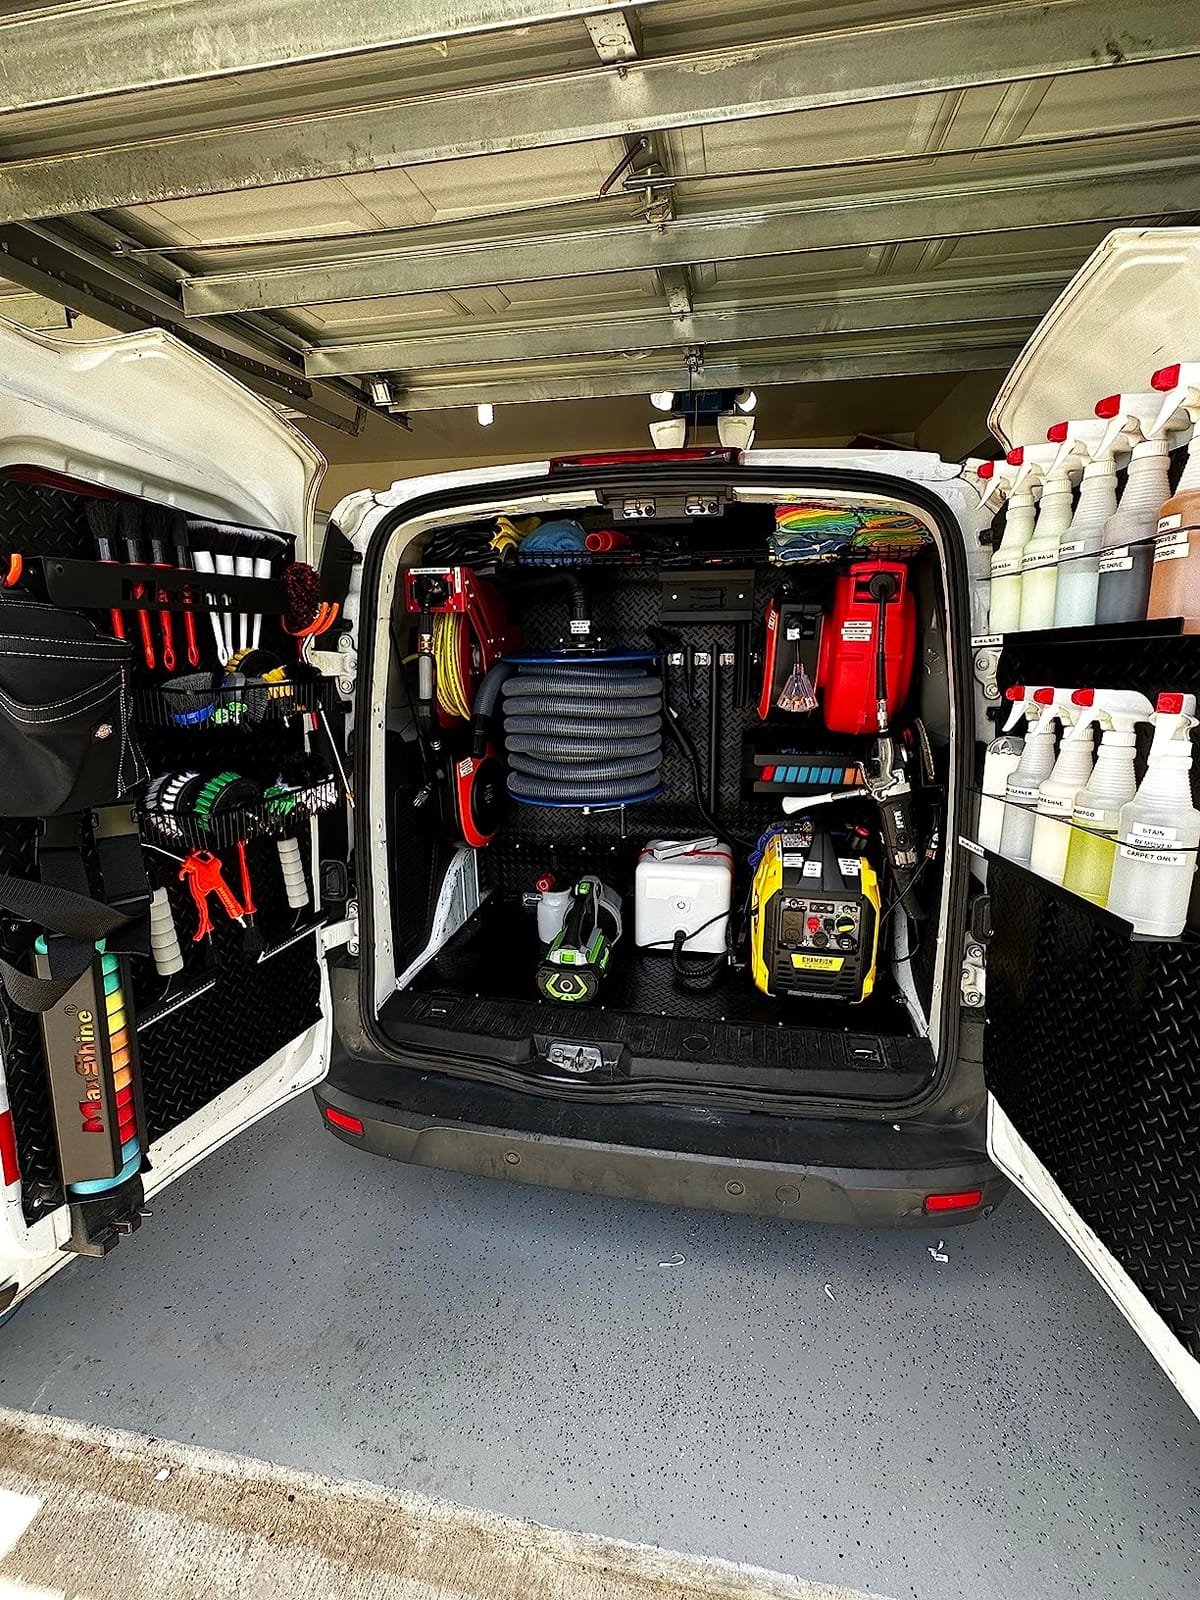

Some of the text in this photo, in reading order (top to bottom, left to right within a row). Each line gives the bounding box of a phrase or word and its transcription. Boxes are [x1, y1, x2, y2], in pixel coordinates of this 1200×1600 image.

[1142, 827, 1166, 836] STAIN
[1126, 849, 1179, 863] CARPET ONLY
